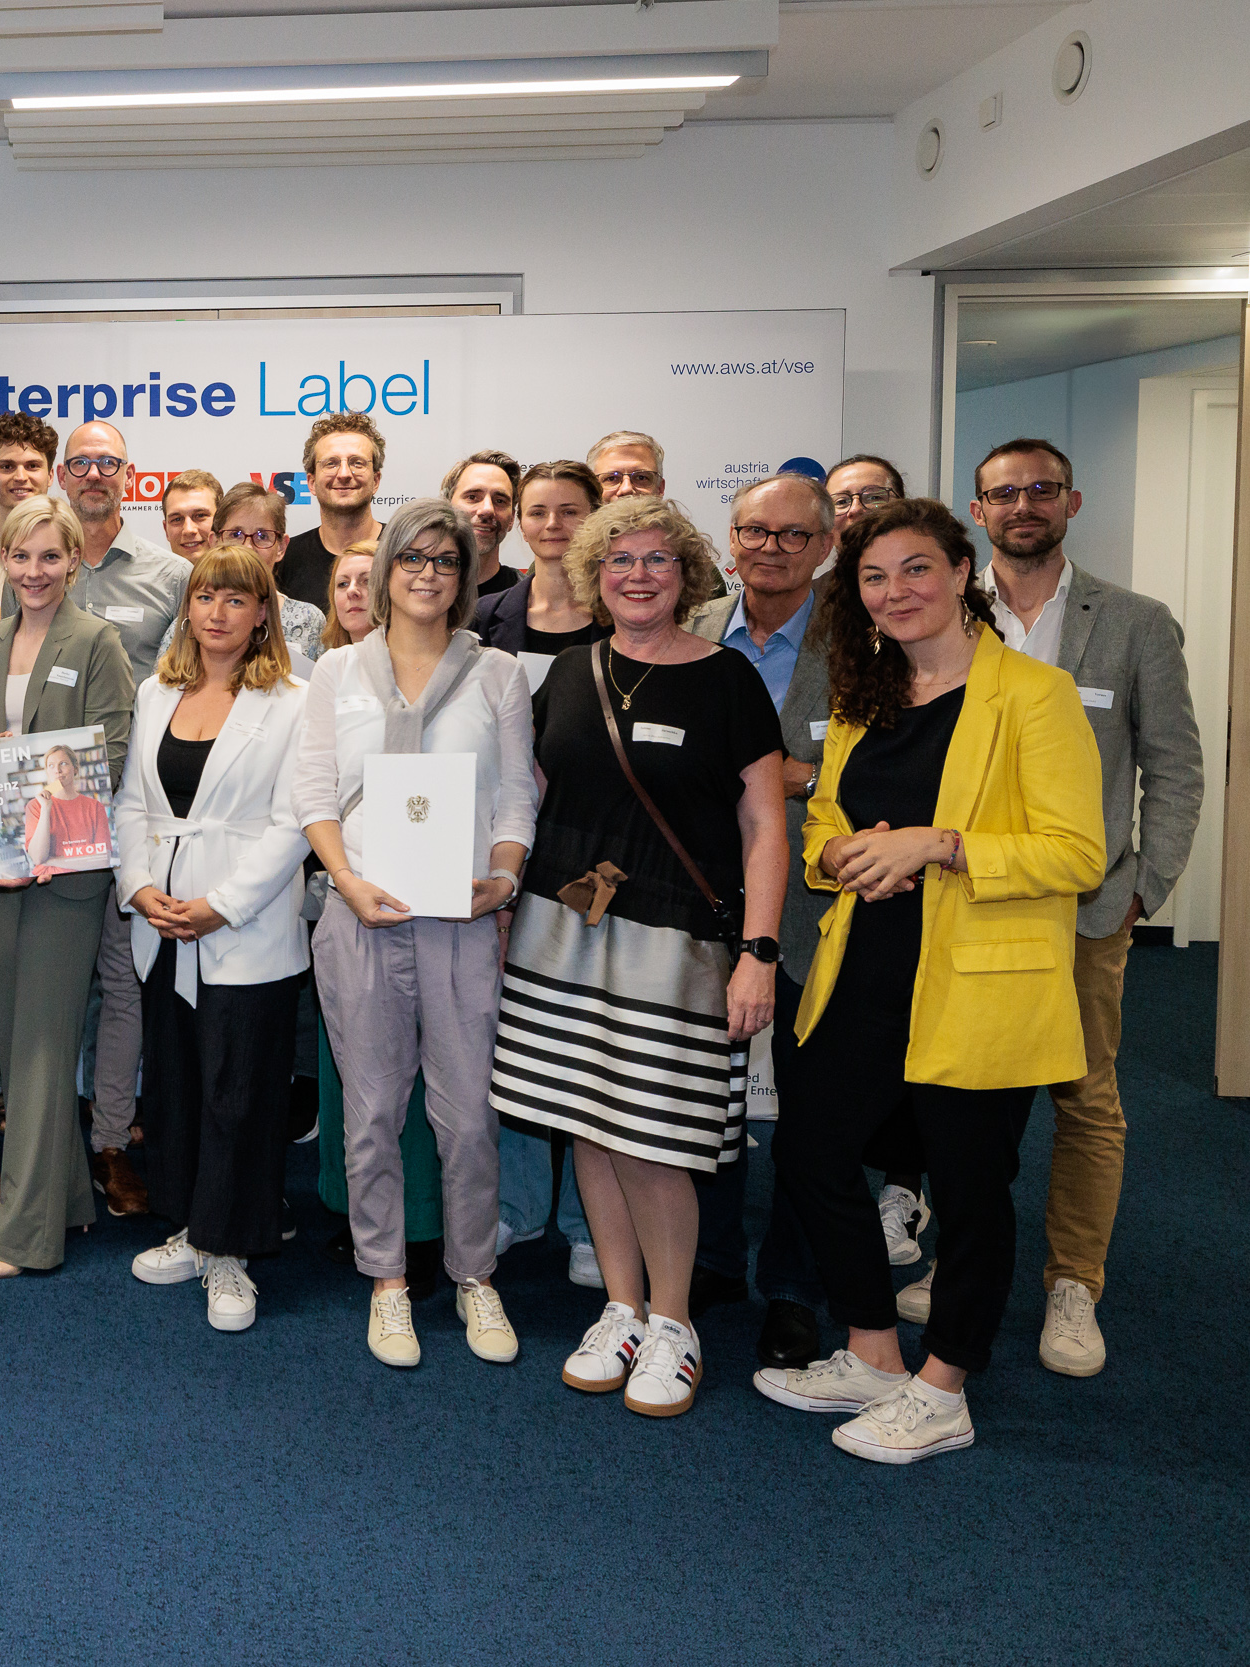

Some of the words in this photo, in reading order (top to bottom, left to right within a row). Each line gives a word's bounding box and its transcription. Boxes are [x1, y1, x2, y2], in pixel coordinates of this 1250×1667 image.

[670, 358, 815, 375] www.aws.at/vse
[259, 359, 430, 417] Label
[724, 461, 770, 473] austria
[751, 1085, 777, 1097] Ente
